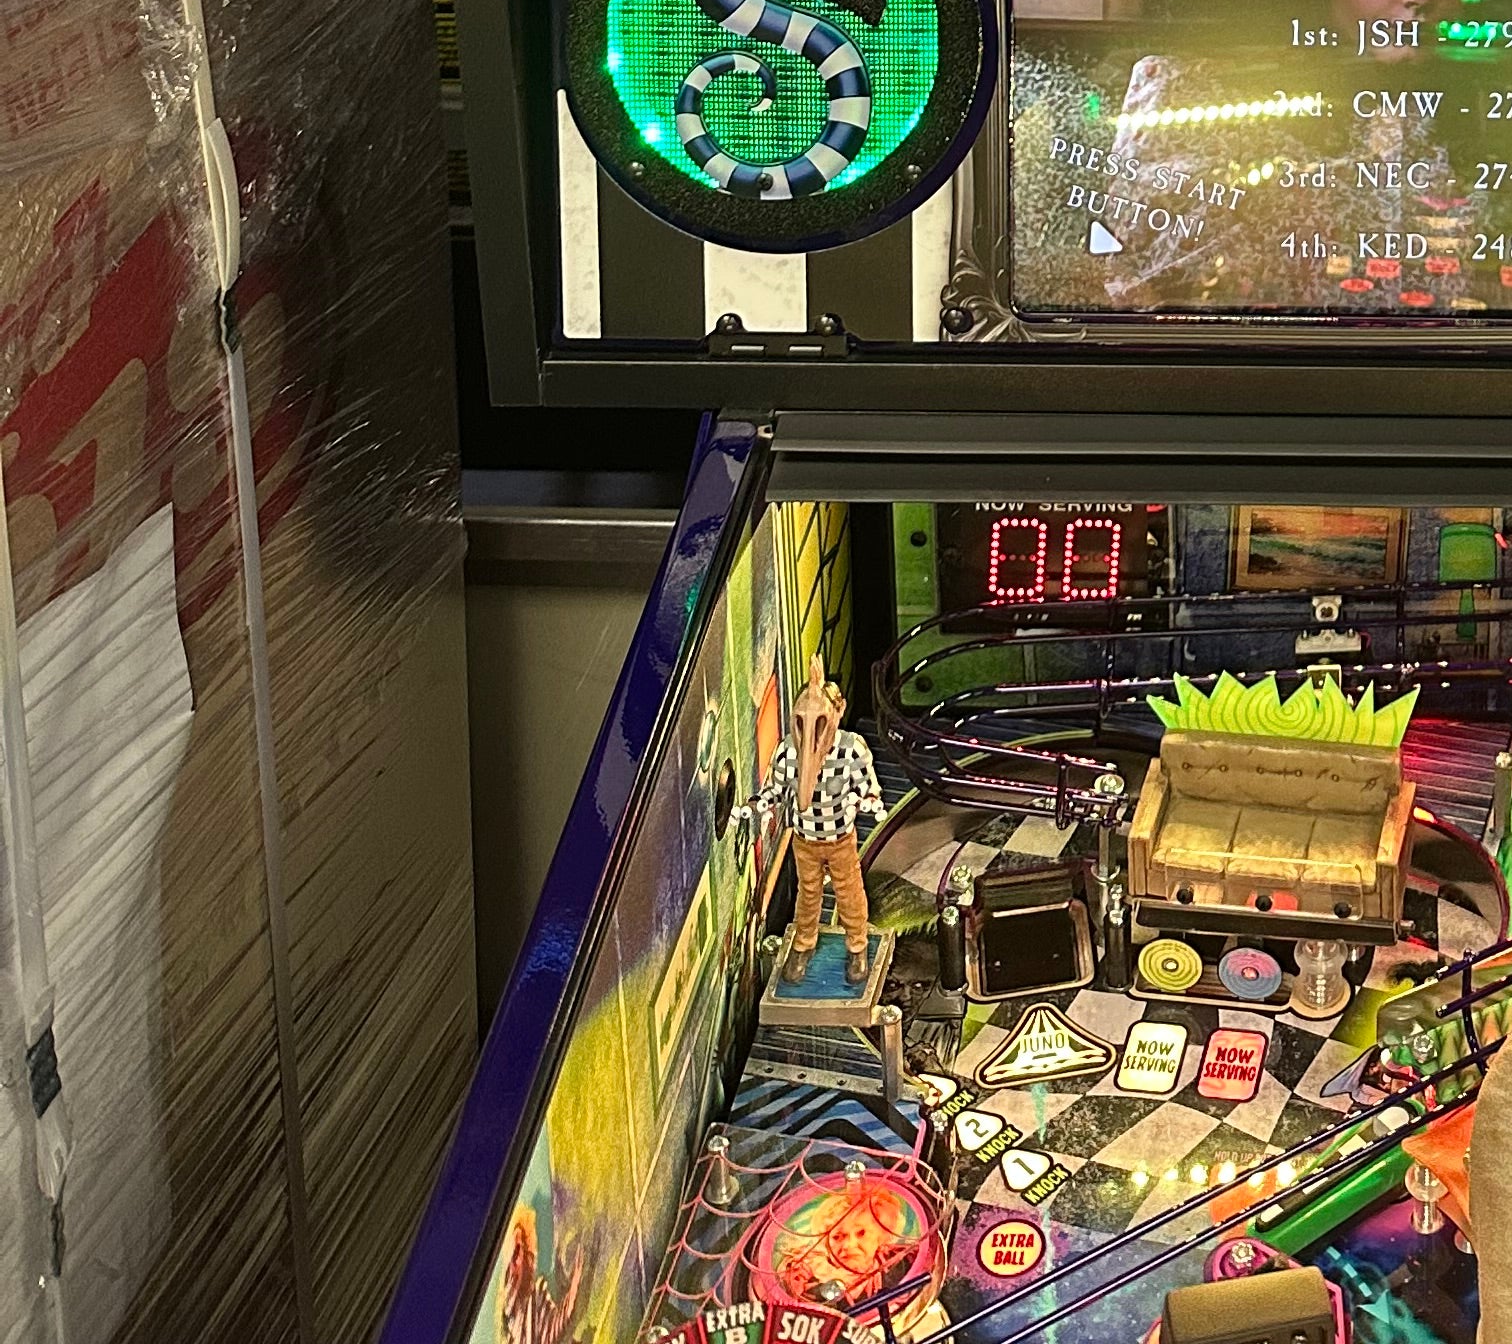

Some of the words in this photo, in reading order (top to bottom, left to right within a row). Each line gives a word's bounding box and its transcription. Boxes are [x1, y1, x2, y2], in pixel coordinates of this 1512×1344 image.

[1290, 18, 1340, 48] 1st:
[1355, 19, 1420, 56] JSH
[1352, 89, 1445, 119] CMW
[1049, 137, 1141, 182] PRESS
[1152, 166, 1247, 211] START
[1278, 160, 1338, 190] 3rd:
[1355, 162, 1432, 190] NEC
[1066, 184, 1206, 242] BUTTON!
[1280, 231, 1339, 260] 4th:
[1358, 233, 1429, 261] KED
[988, 517, 1122, 598] 00
[1022, 1032, 1065, 1054] JUNO
[1135, 1039, 1175, 1057] NOW
[1214, 1046, 1255, 1064] NOW
[1123, 1055, 1177, 1075] SERVING
[1202, 1062, 1257, 1082] SERVING
[940, 1090, 975, 1119] NOCK
[964, 1118, 990, 1138] 2
[975, 1125, 1021, 1164] KNOCK
[1011, 1156, 1036, 1176] 1
[1023, 1165, 1069, 1205] KNOCK
[991, 1232, 1035, 1248] EXTRA
[993, 1250, 1026, 1266] BALL
[704, 1300, 766, 1333] EXTRA
